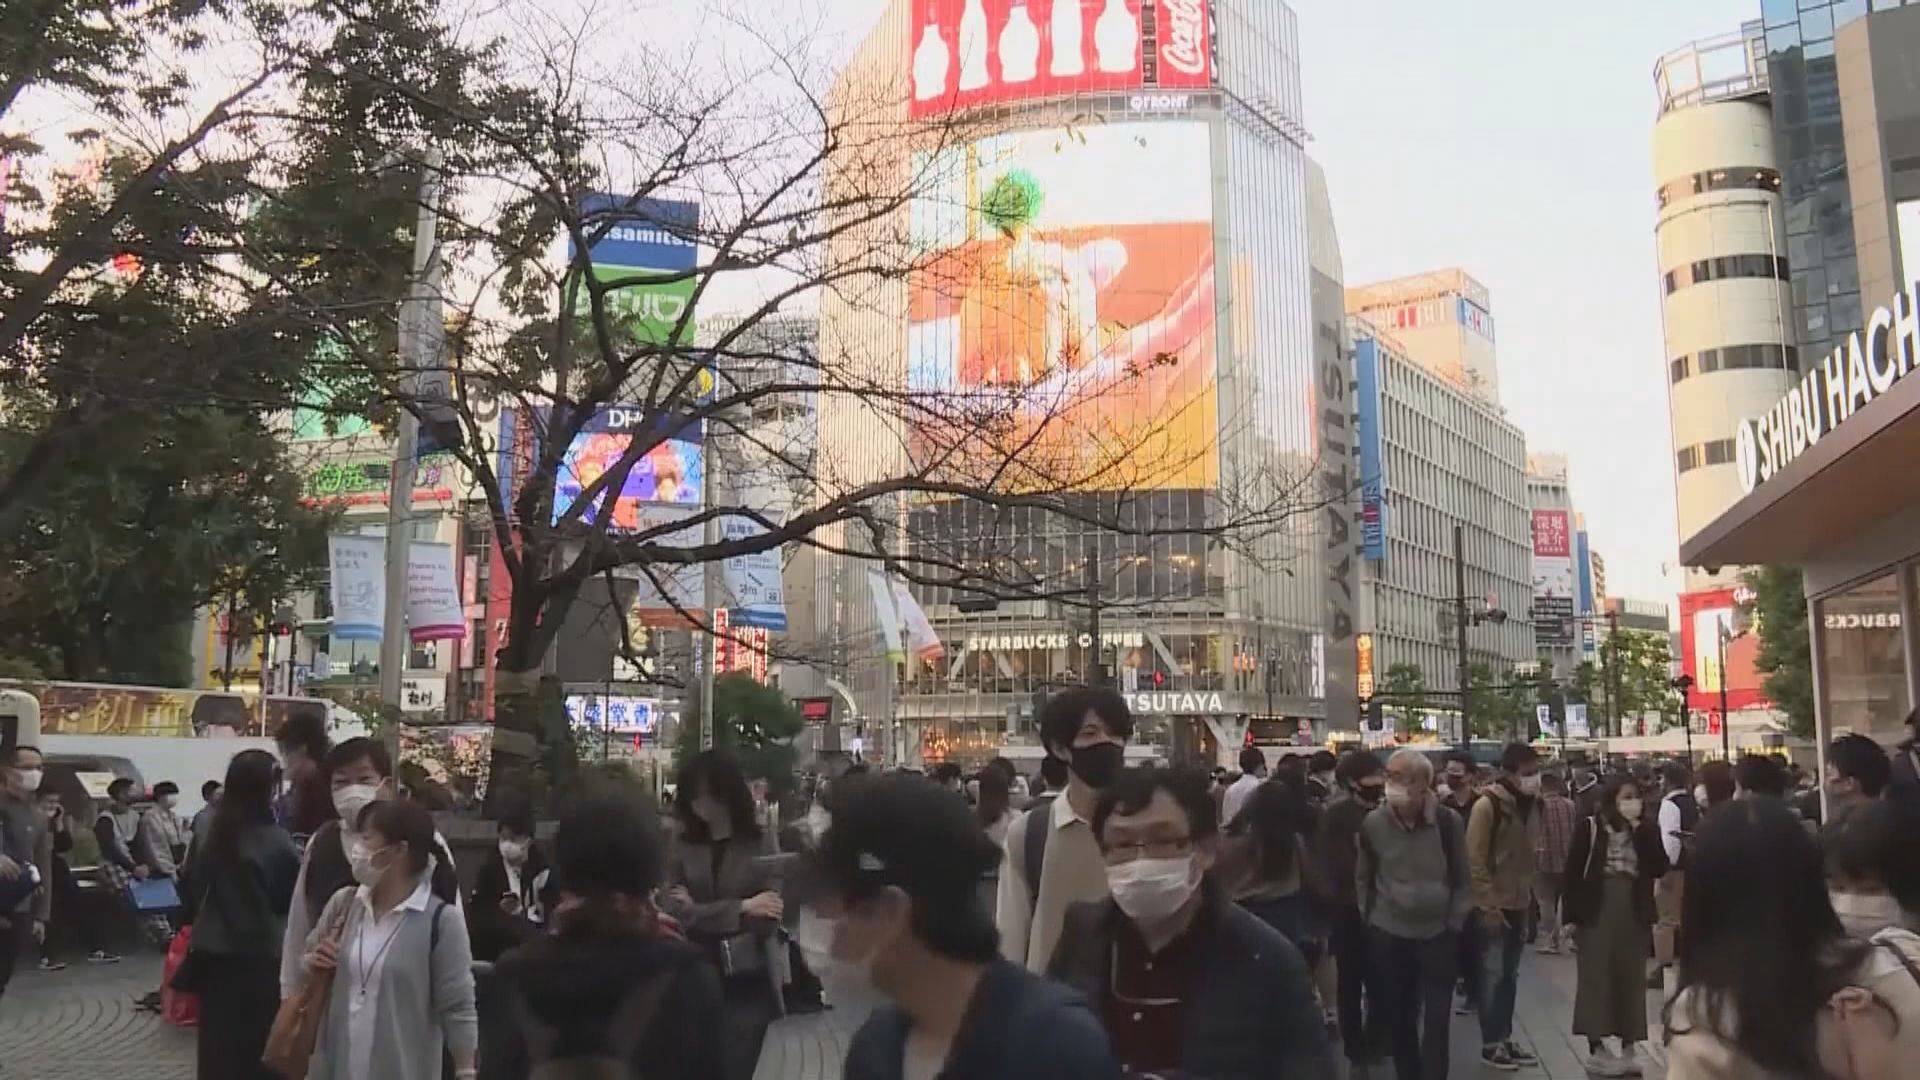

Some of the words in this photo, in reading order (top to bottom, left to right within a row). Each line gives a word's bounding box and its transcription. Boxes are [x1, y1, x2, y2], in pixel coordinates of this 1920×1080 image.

[1130, 95, 1189, 112] QFRONT
[1758, 368, 1821, 481] SHIBU
[1319, 319, 1352, 642] TSUTAYA
[968, 633, 1069, 650] STARBUCKS
[1122, 692, 1223, 712] TSUTAYA
